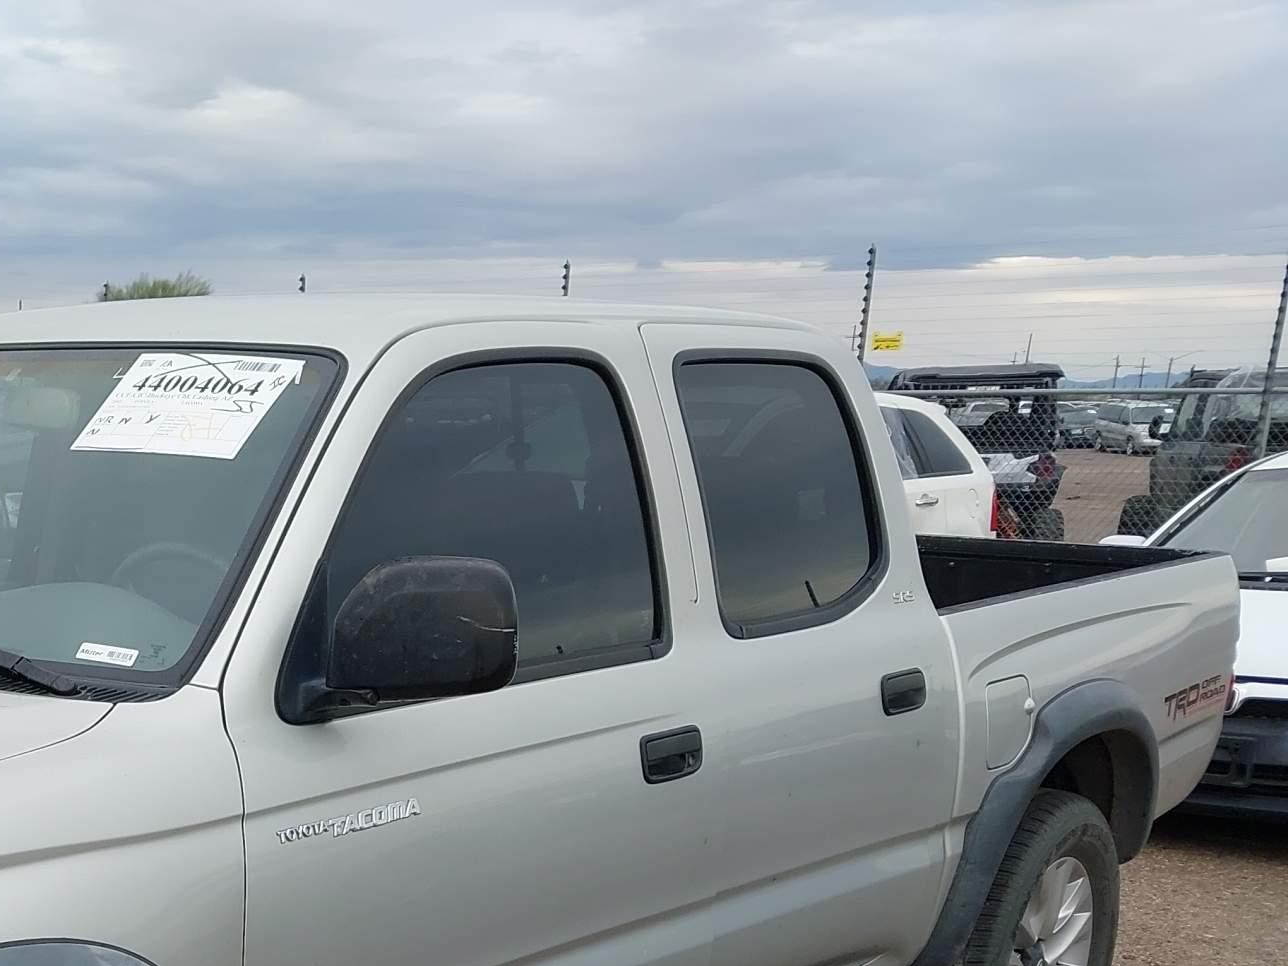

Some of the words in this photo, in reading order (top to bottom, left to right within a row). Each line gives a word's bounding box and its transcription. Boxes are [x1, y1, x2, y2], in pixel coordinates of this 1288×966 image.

[133, 373, 265, 396] 44004064
[1164, 682, 1201, 721] TRD
[1201, 674, 1222, 690] OFF
[1199, 684, 1226, 702] ROAD
[276, 821, 329, 844] TOYOTA
[328, 798, 422, 837] TACOMA
